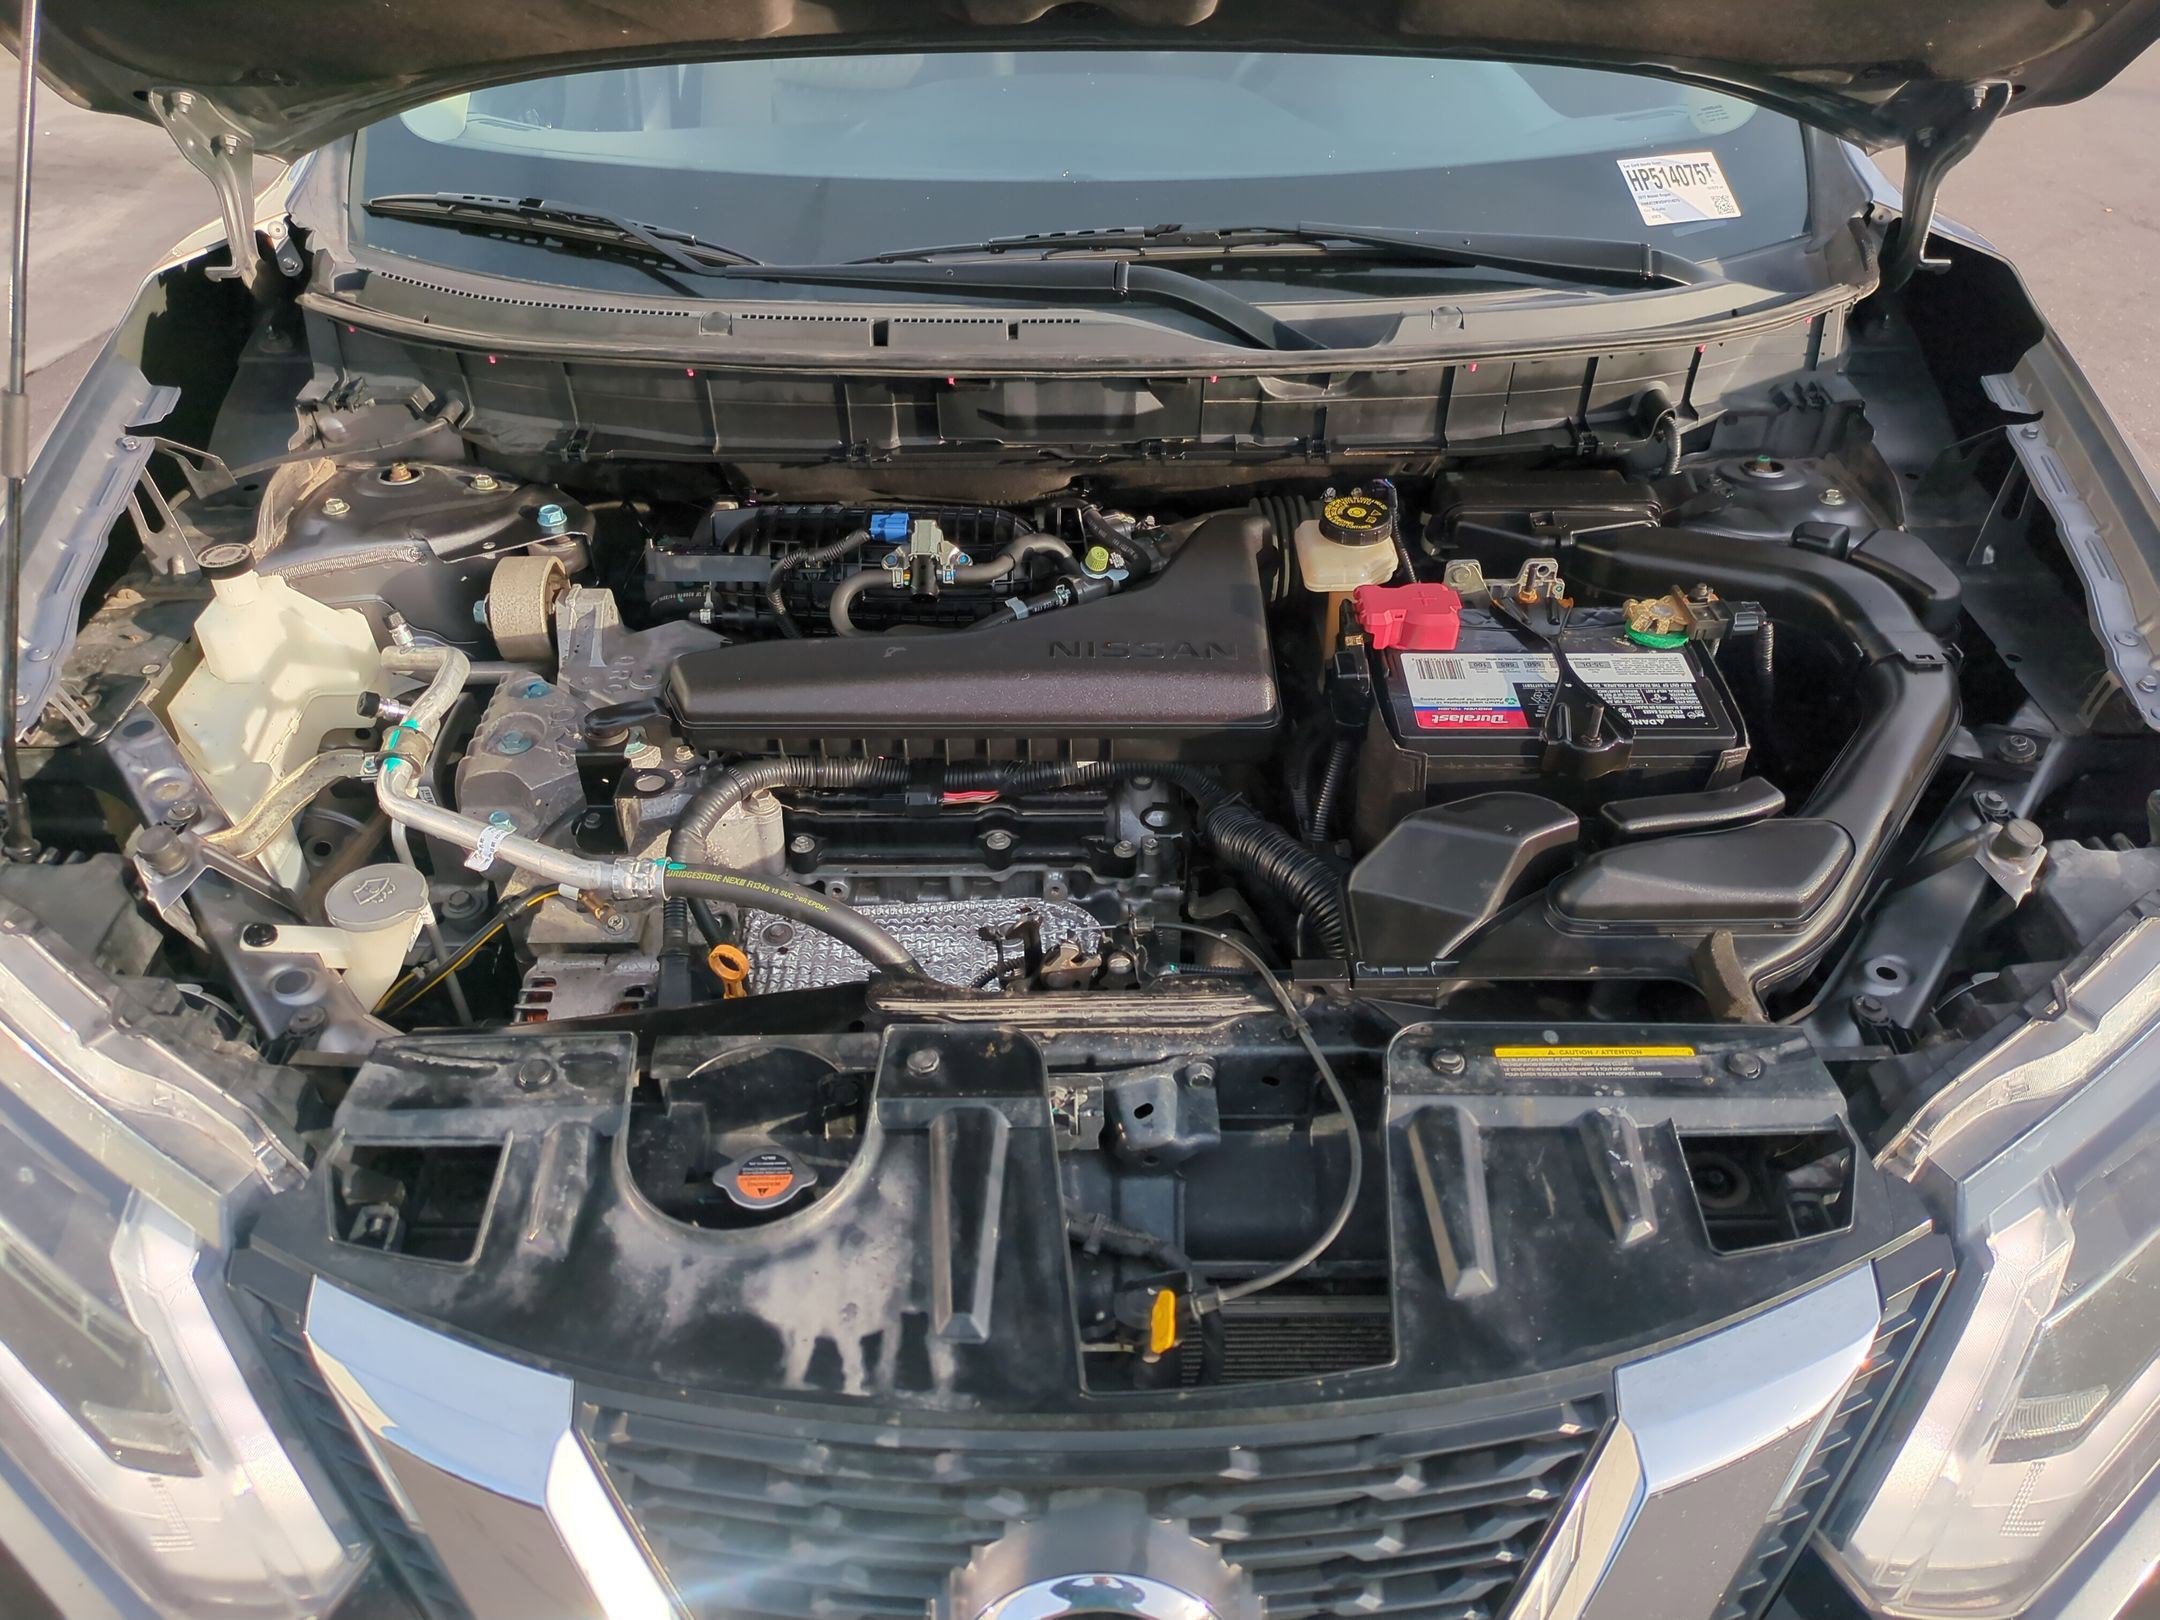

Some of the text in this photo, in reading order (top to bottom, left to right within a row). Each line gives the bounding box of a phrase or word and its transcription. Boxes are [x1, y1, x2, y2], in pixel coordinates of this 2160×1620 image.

[1626, 163, 1712, 191] HP514075T
[1049, 640, 1240, 660] NISSAN
[1431, 714, 1508, 724] Duralast
[665, 870, 723, 882] BRIDGESTONE
[746, 881, 770, 892] R134a
